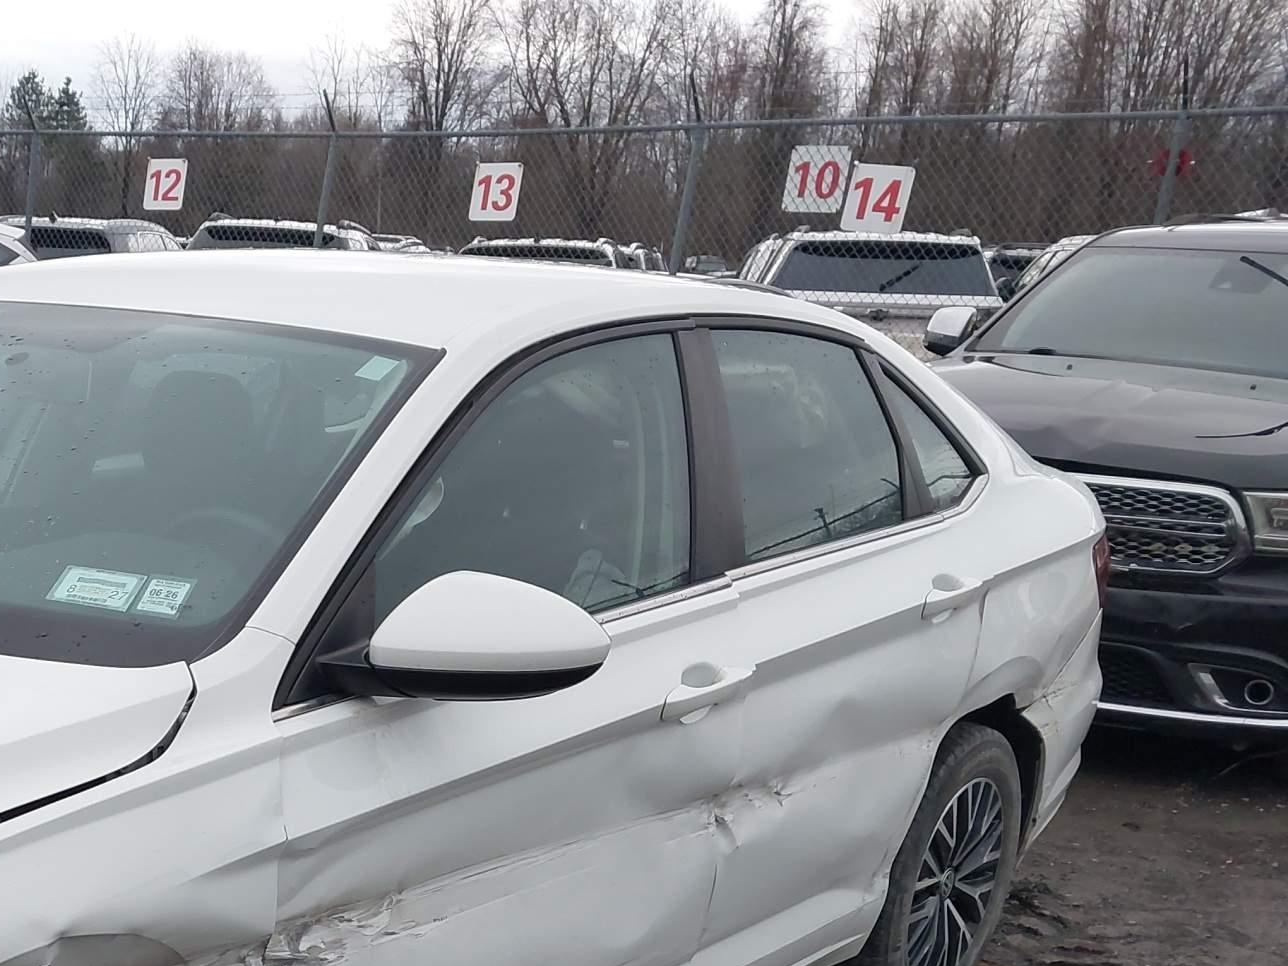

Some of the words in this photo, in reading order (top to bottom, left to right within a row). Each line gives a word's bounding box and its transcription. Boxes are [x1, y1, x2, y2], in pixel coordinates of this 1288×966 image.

[150, 168, 182, 201] 12
[477, 174, 515, 211] 13
[794, 161, 840, 198] 10
[853, 178, 902, 222] 14
